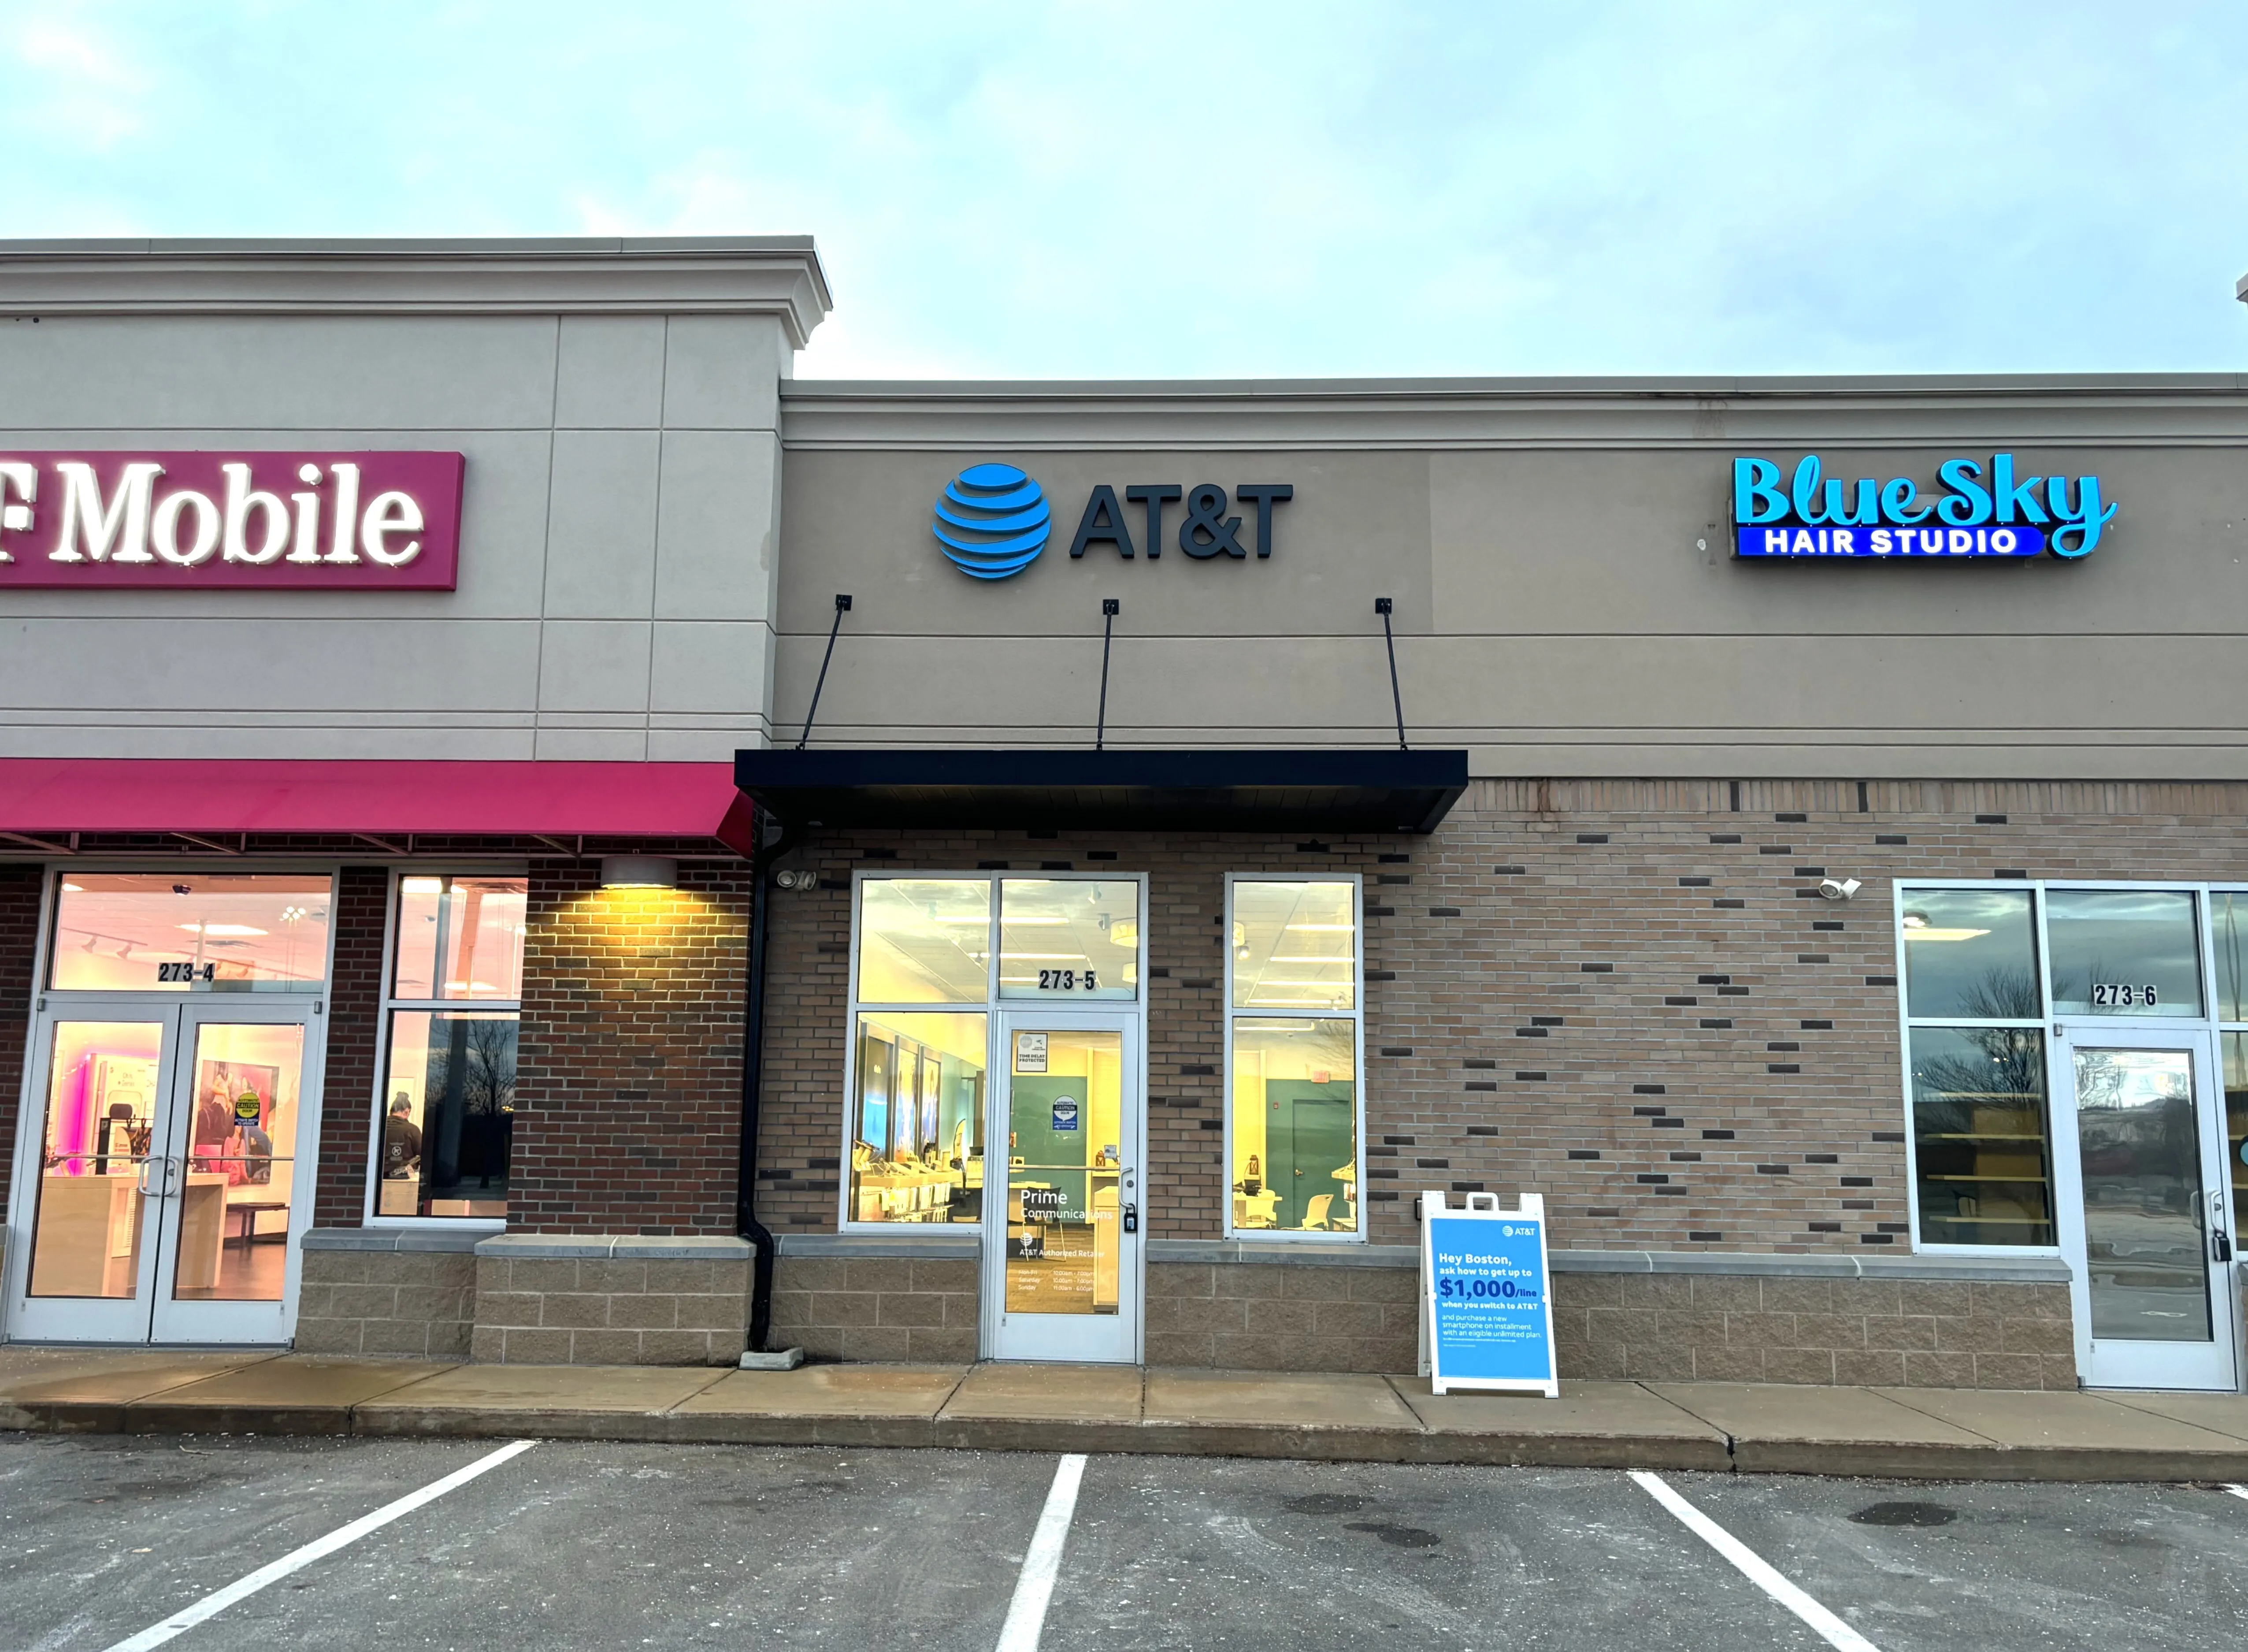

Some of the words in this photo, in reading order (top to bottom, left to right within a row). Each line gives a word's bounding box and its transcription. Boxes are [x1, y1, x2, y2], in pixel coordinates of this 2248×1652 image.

[49, 462, 424, 567] Mobile
[1732, 454, 1933, 527] Blue
[1936, 453, 2118, 558] Sky
[1069, 484, 1293, 559] AT&T
[1765, 530, 1855, 554] HAIR
[1870, 529, 2017, 554] STUDIO
[159, 963, 213, 982] 273-4
[1039, 969, 1095, 990] 273-5
[2095, 985, 2156, 1006] 273-6
[1020, 1189, 1068, 1205] Prime
[1020, 1208, 1113, 1220] Communicaions
[1514, 1227, 1536, 1236] AT&T
[1439, 1252, 1462, 1266] Hey
[1465, 1253, 1512, 1266] Boston,
[1439, 1266, 1455, 1275] ask
[1457, 1266, 1477, 1275] how
[1478, 1267, 1489, 1276] to
[1491, 1269, 1506, 1277] get
[1508, 1270, 1520, 1278] up
[1521, 1269, 1532, 1277] to
[1468, 1330, 1492, 1338] eligible
[1526, 1331, 1542, 1339] plan.
